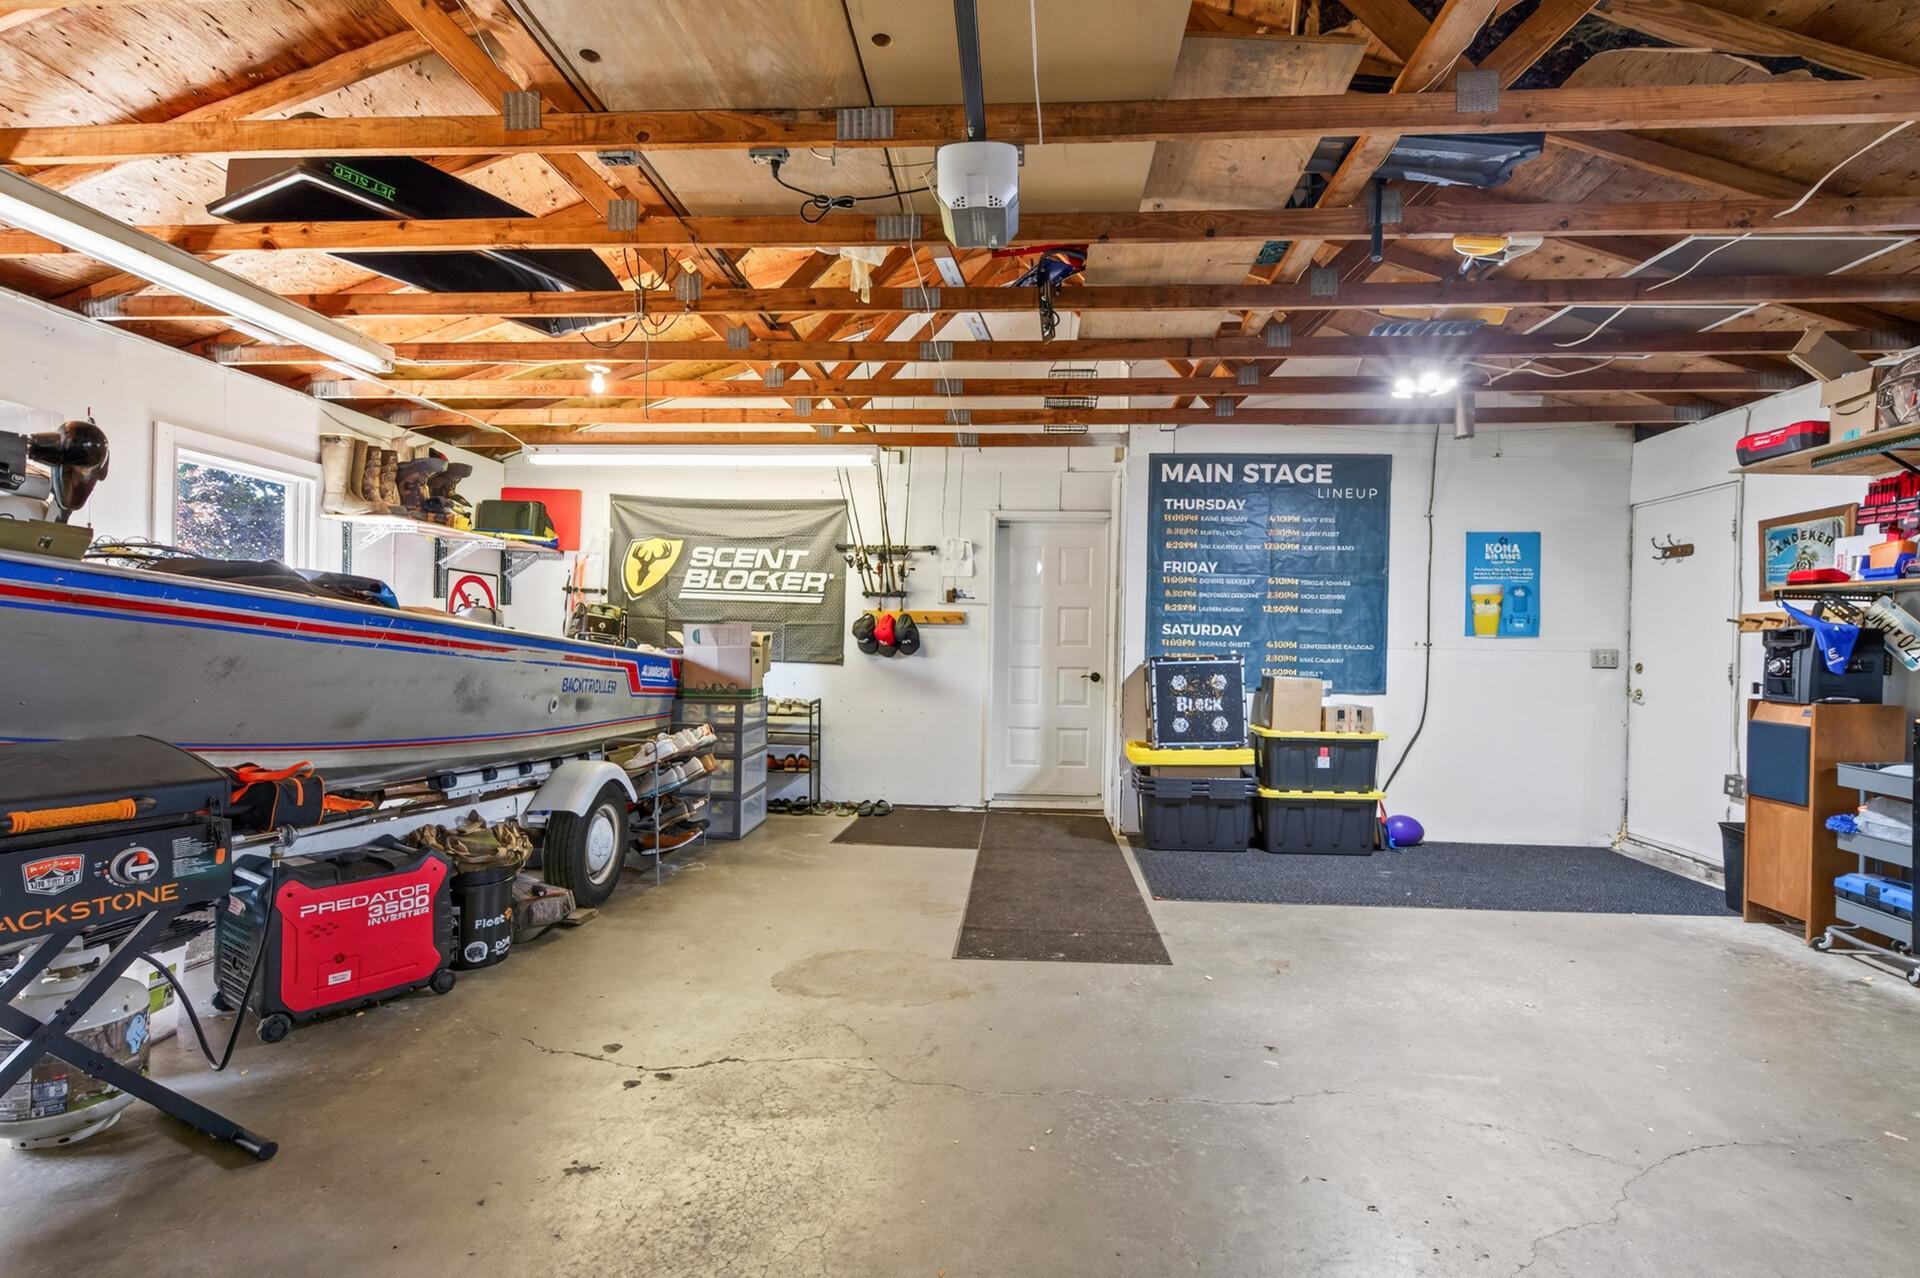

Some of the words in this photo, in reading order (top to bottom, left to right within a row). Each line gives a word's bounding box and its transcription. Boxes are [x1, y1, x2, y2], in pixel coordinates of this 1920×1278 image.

[333, 166, 369, 187] SLED
[369, 182, 396, 200] JET
[1161, 463, 1233, 483] MAIN
[1242, 463, 1333, 484] STAGE
[1317, 488, 1378, 499] LINEUP
[1164, 499, 1246, 510] THURSDAY
[1775, 529, 1835, 555] ANDEKER
[689, 546, 810, 570] SCENT
[1163, 561, 1218, 574] FRIDAY
[682, 568, 828, 593] BLOCKER
[1162, 623, 1243, 637] SATURDAY
[561, 677, 617, 695] BACKTROLLER
[1176, 696, 1224, 712] BLOCK
[300, 883, 430, 919] PREDATOR
[367, 906, 430, 927] INVERTER
